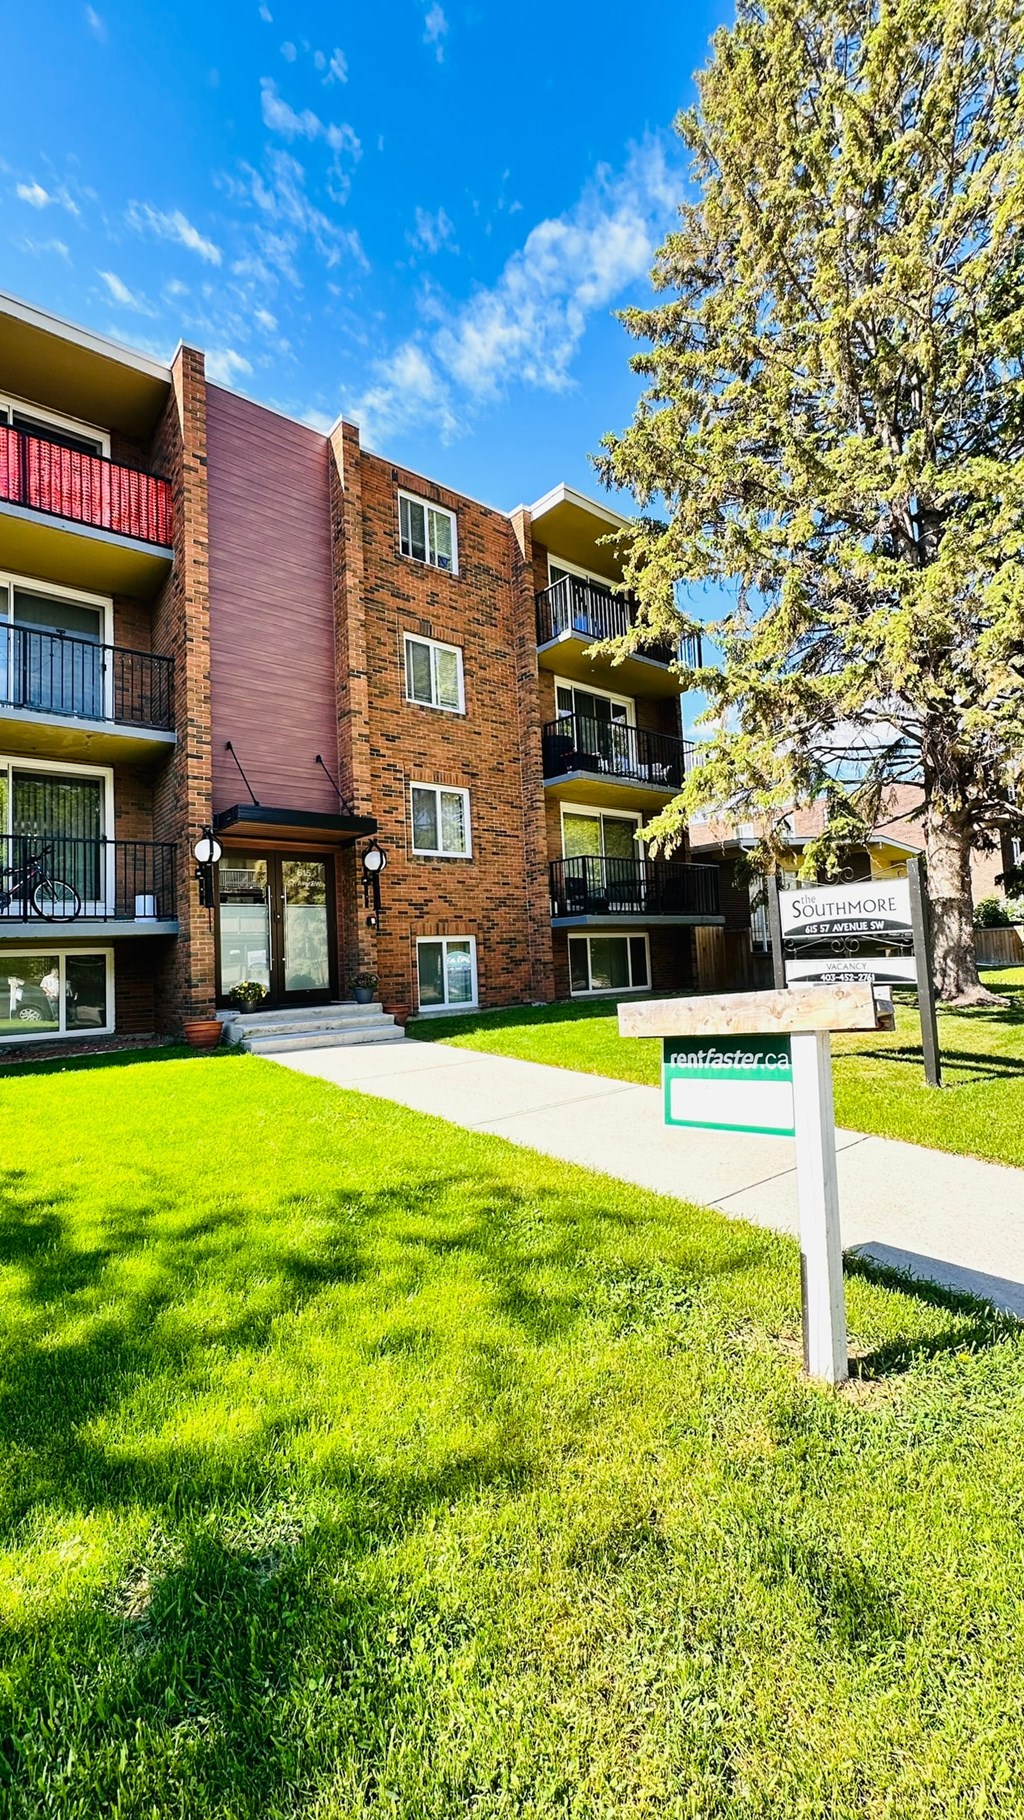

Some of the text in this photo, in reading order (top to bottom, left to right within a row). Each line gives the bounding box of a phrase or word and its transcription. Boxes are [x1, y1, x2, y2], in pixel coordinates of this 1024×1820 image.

[801, 894, 816, 904] the
[792, 897, 897, 919] SOUTHMORE
[805, 920, 885, 934] 615 57 AVENUE SW
[826, 962, 867, 971] VACANCY
[820, 973, 876, 983] 403-452-2761
[670, 1047, 791, 1070] rentfaster.ca
